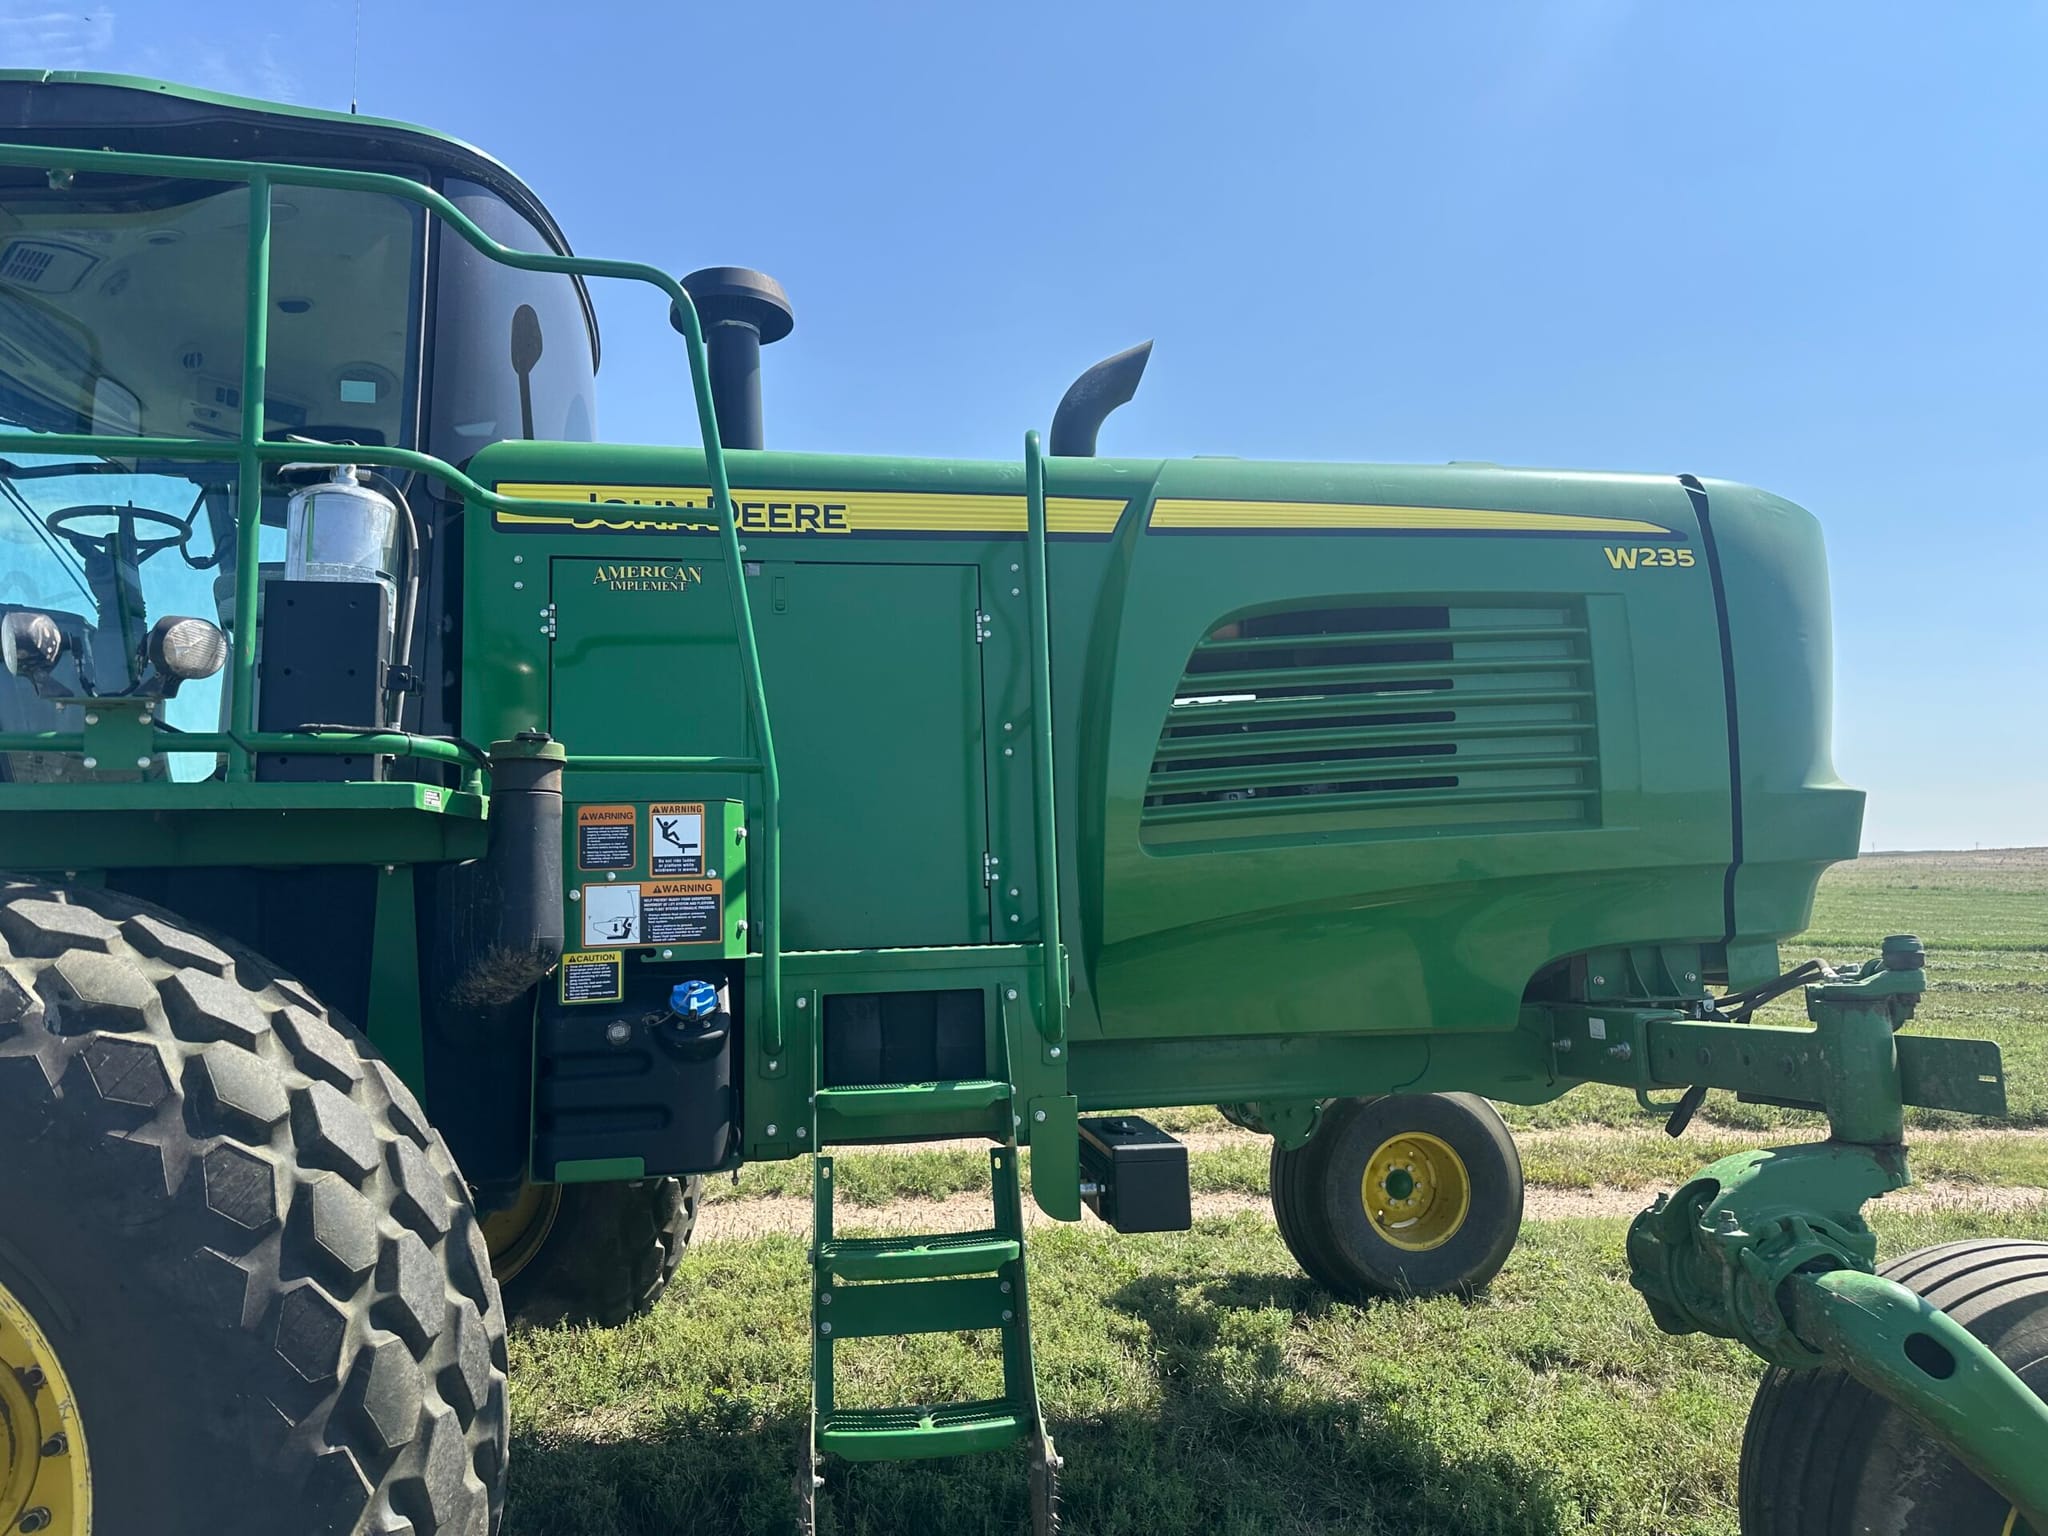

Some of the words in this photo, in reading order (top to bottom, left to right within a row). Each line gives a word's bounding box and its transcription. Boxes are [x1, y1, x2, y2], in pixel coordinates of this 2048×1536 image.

[1603, 547, 1696, 570] W235
[593, 565, 703, 585] AMERICAN
[610, 580, 688, 592] IMPLEMENT
[661, 805, 702, 813] WARNING
[590, 812, 633, 820] WARNING
[662, 883, 713, 893] WARNING
[577, 954, 616, 963] CAUTION
